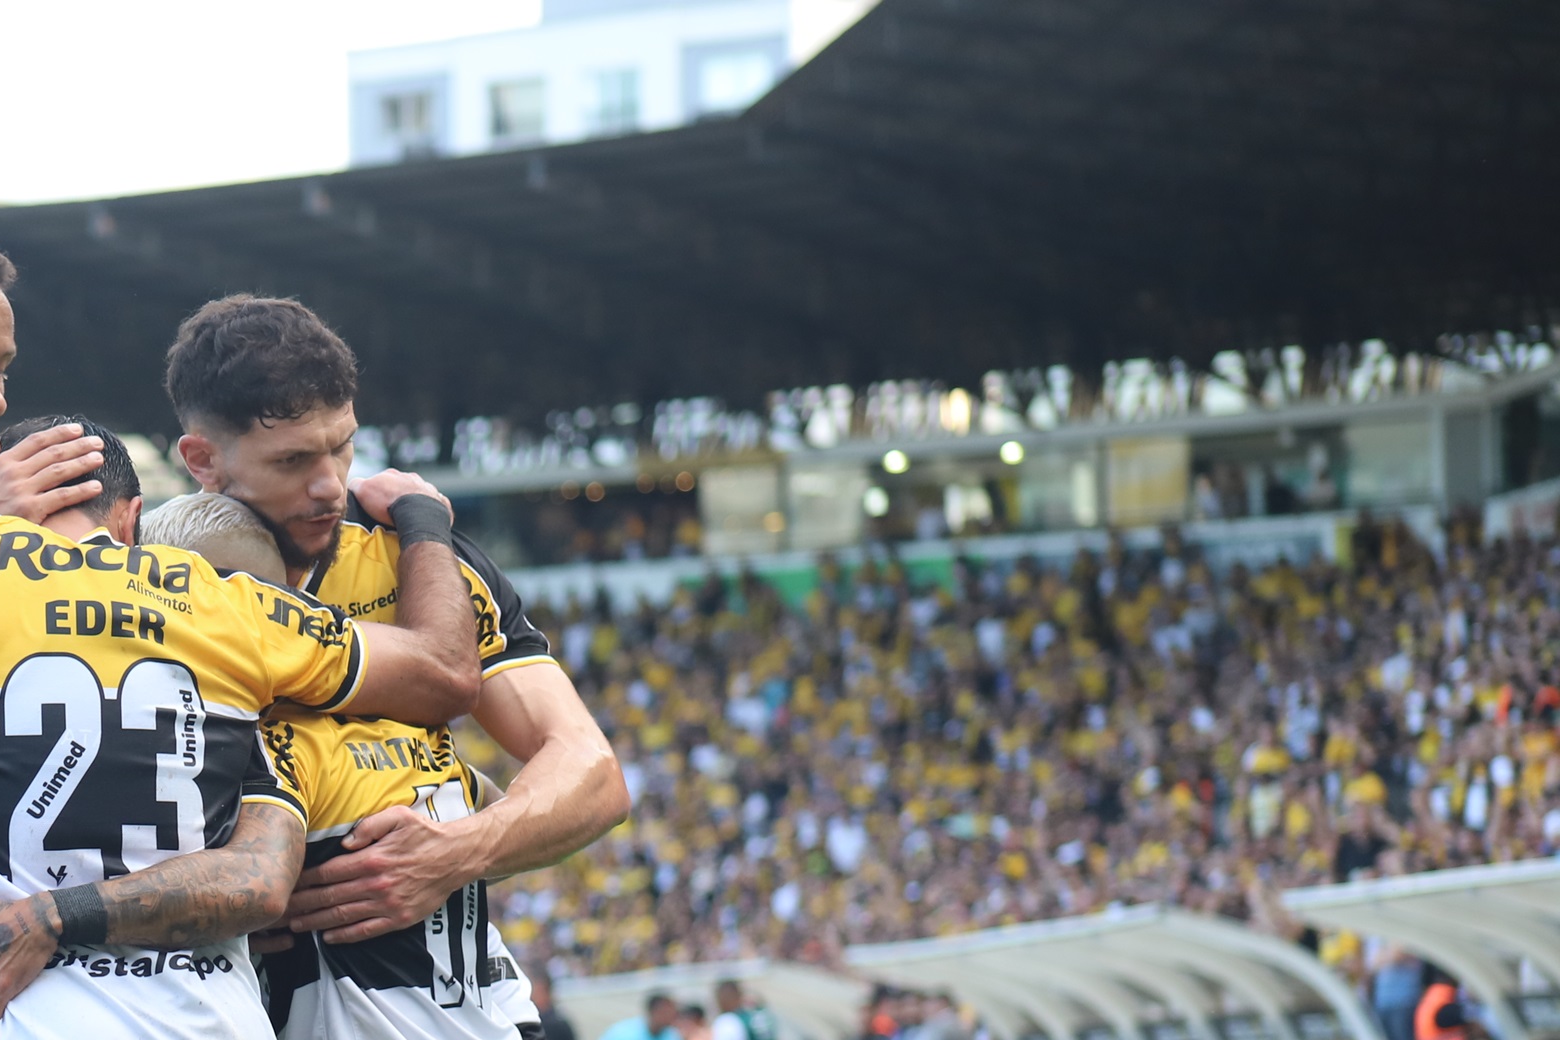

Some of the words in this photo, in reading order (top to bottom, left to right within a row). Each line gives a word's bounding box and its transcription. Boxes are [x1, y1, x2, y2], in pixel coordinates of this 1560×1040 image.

[45, 599, 166, 645] EDER
[126, 578, 193, 616] Alimentos
[178, 689, 198, 767] Unimed
[0, 651, 206, 886] 23
[26, 740, 87, 820] Unimed
